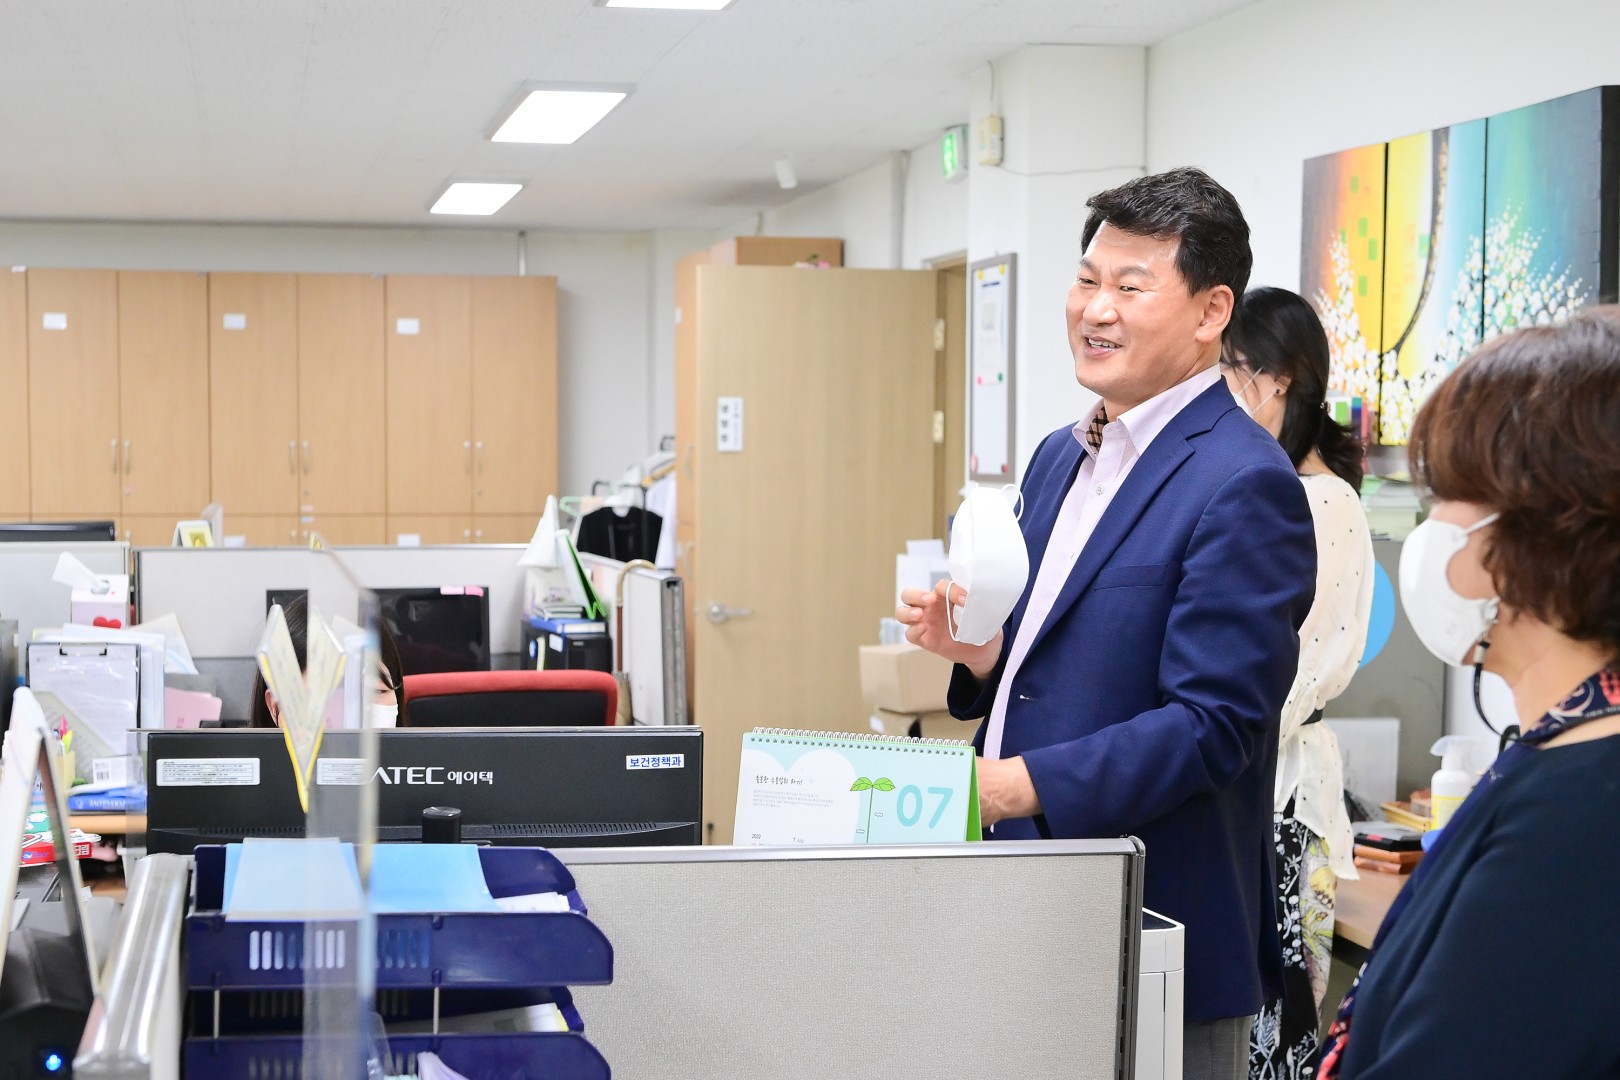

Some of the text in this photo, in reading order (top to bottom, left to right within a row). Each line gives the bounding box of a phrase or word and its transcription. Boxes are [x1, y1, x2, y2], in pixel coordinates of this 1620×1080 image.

[629, 756, 681, 768] 보건정책과
[370, 766, 445, 785] ATEC
[447, 771, 493, 785] 에이텍
[897, 785, 954, 829] 07
